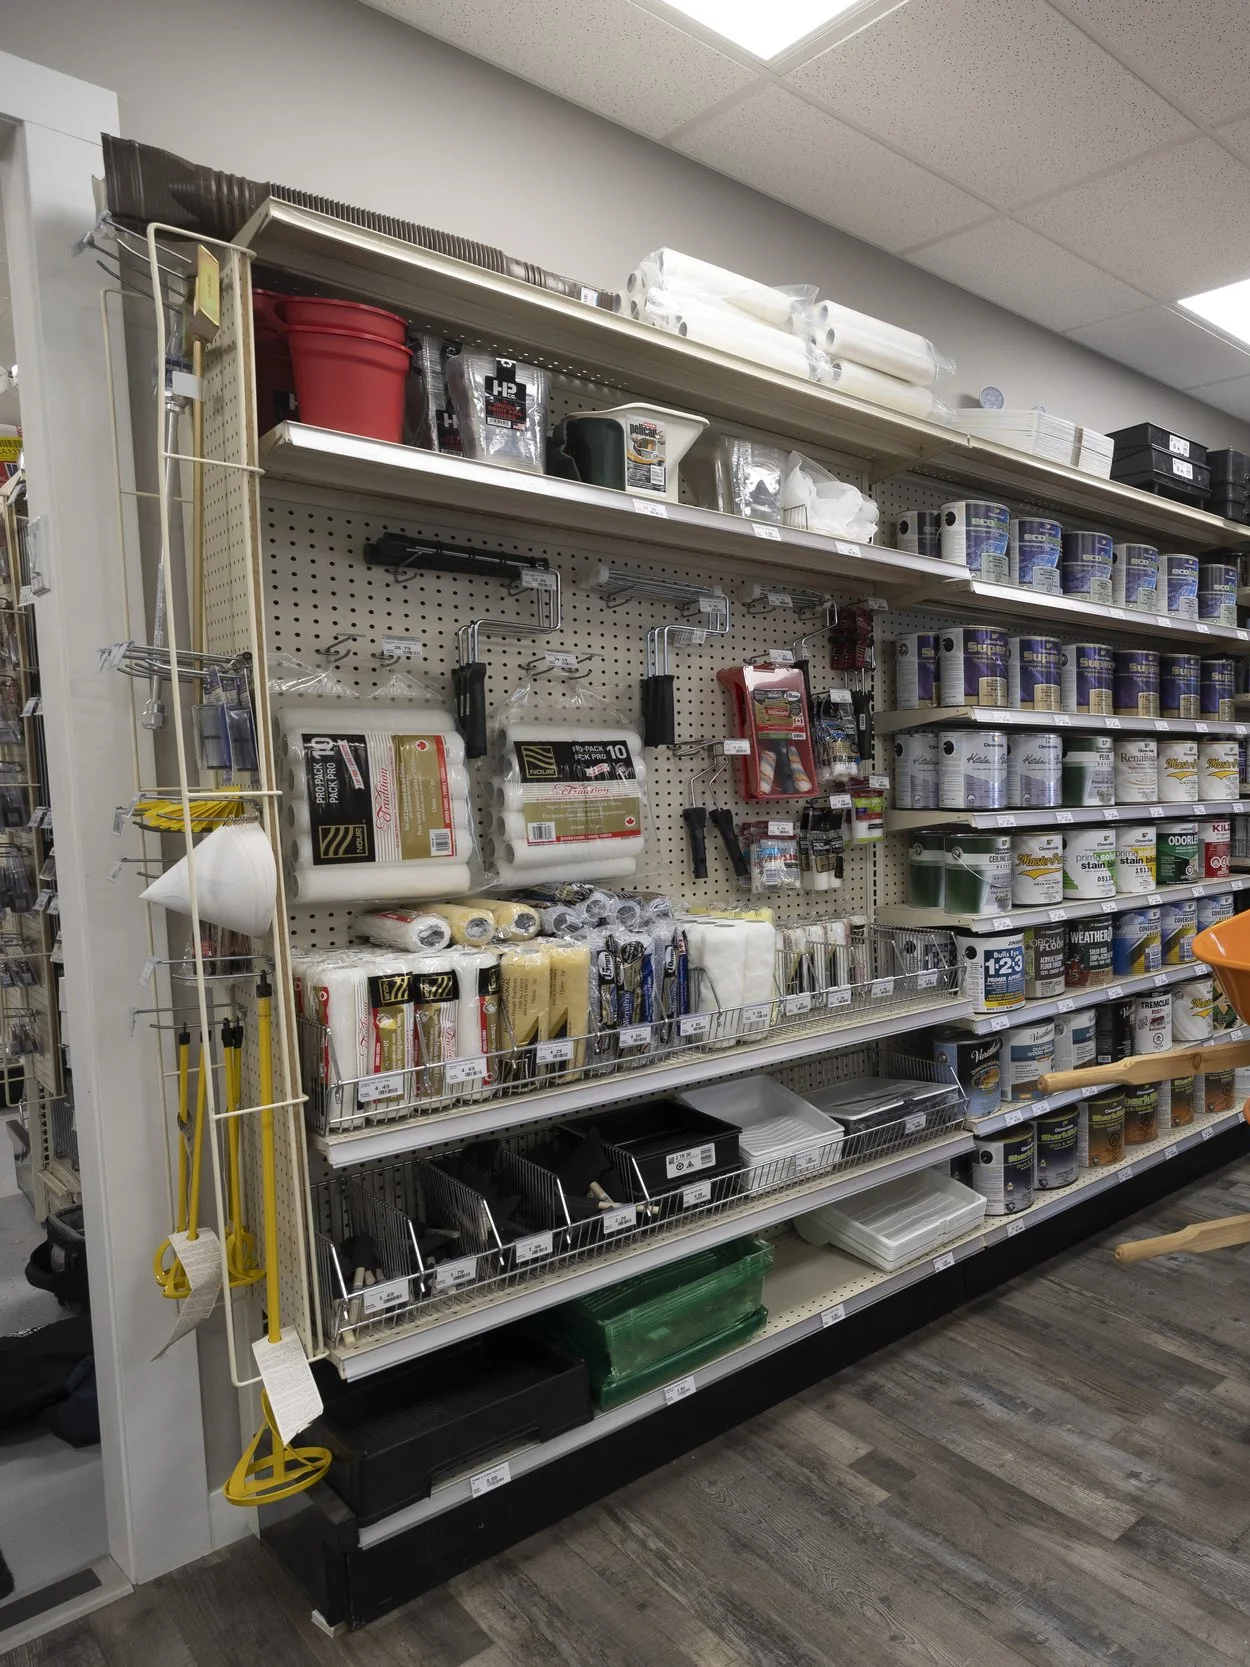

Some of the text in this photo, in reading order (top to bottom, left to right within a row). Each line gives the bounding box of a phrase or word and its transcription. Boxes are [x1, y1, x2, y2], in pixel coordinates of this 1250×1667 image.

[310, 738, 334, 759] 10
[606, 745, 627, 759] 10
[327, 762, 339, 803] PACK PRO
[376, 768, 392, 831] Tradition
[356, 828, 364, 853] NOUR
